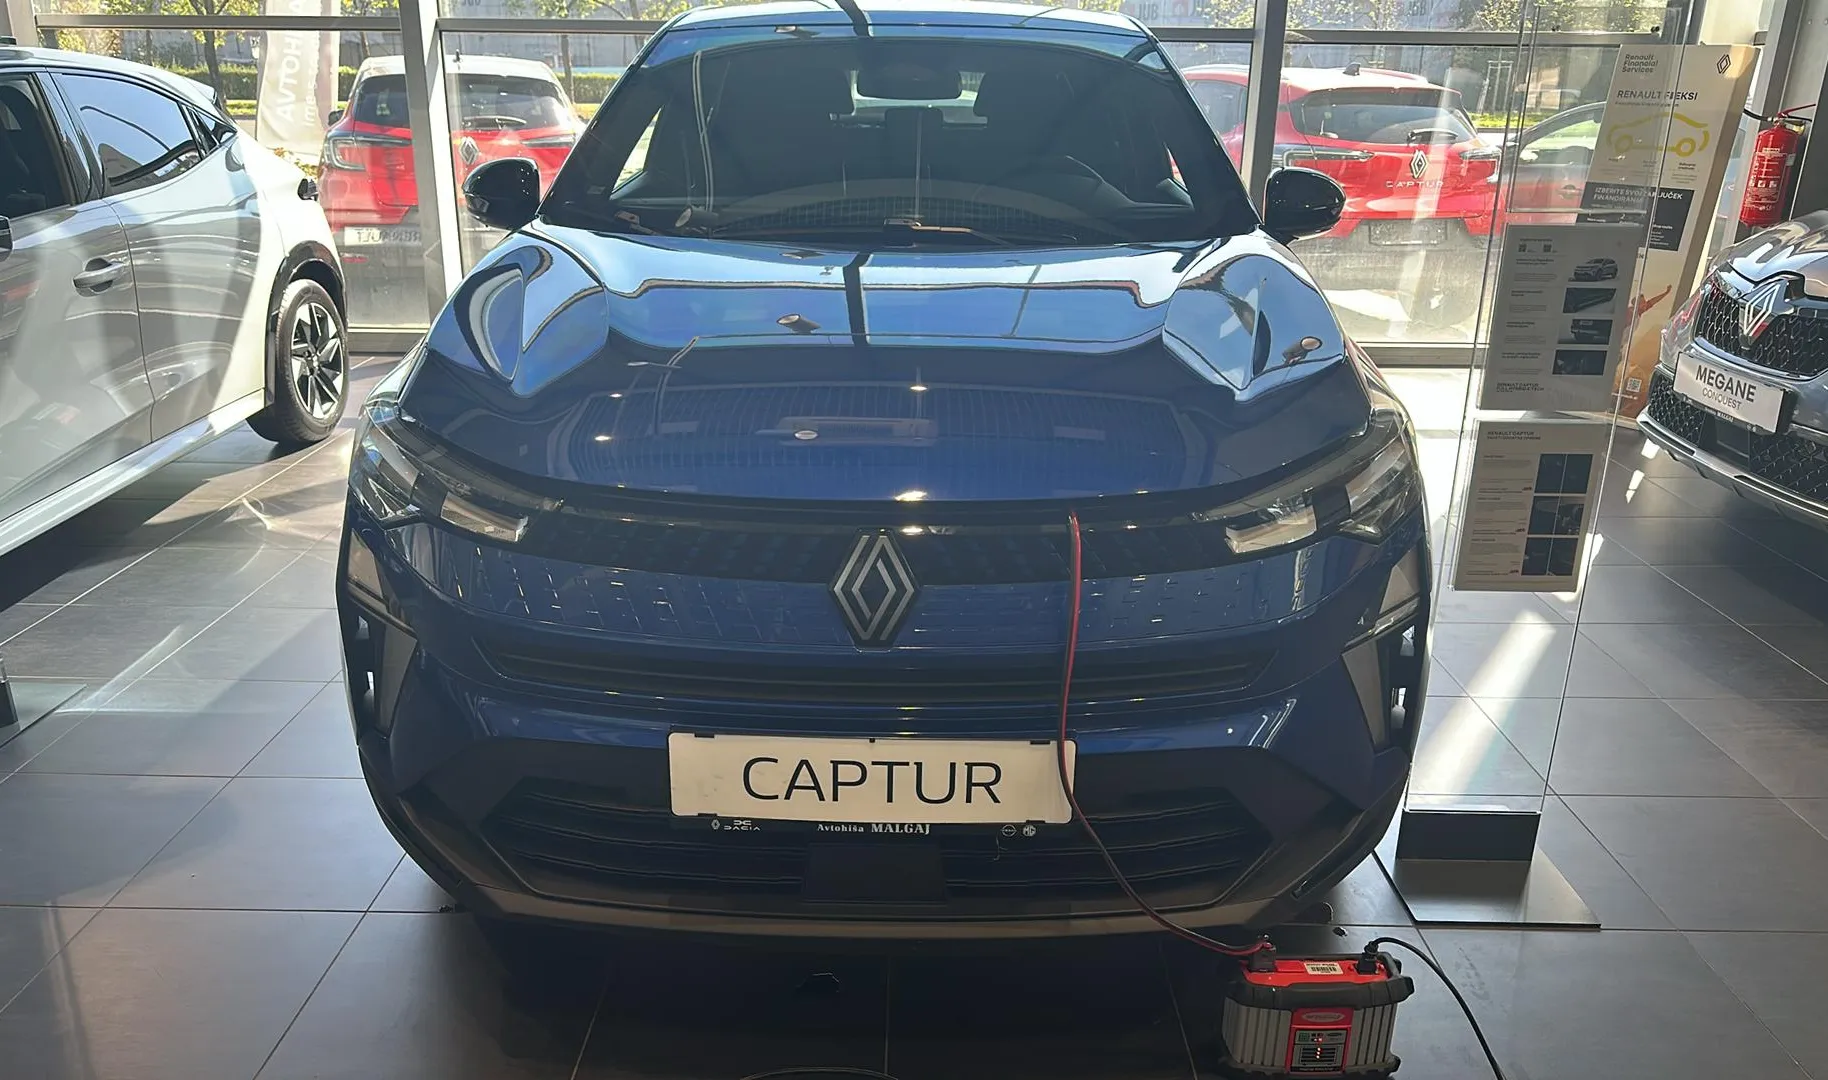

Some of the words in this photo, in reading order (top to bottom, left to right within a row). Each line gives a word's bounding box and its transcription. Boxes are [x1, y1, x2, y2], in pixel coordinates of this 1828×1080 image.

[276, 0, 302, 120] AVTOHIA
[1617, 90, 1661, 100] RENAULT
[1386, 180, 1444, 188] CAPTUR
[1695, 365, 1757, 403] MEGANE
[1702, 387, 1742, 411] CONQUEST
[742, 756, 1002, 804] CAPTUR
[817, 823, 865, 833] Avtohiša
[871, 823, 931, 835] MALGAJ
